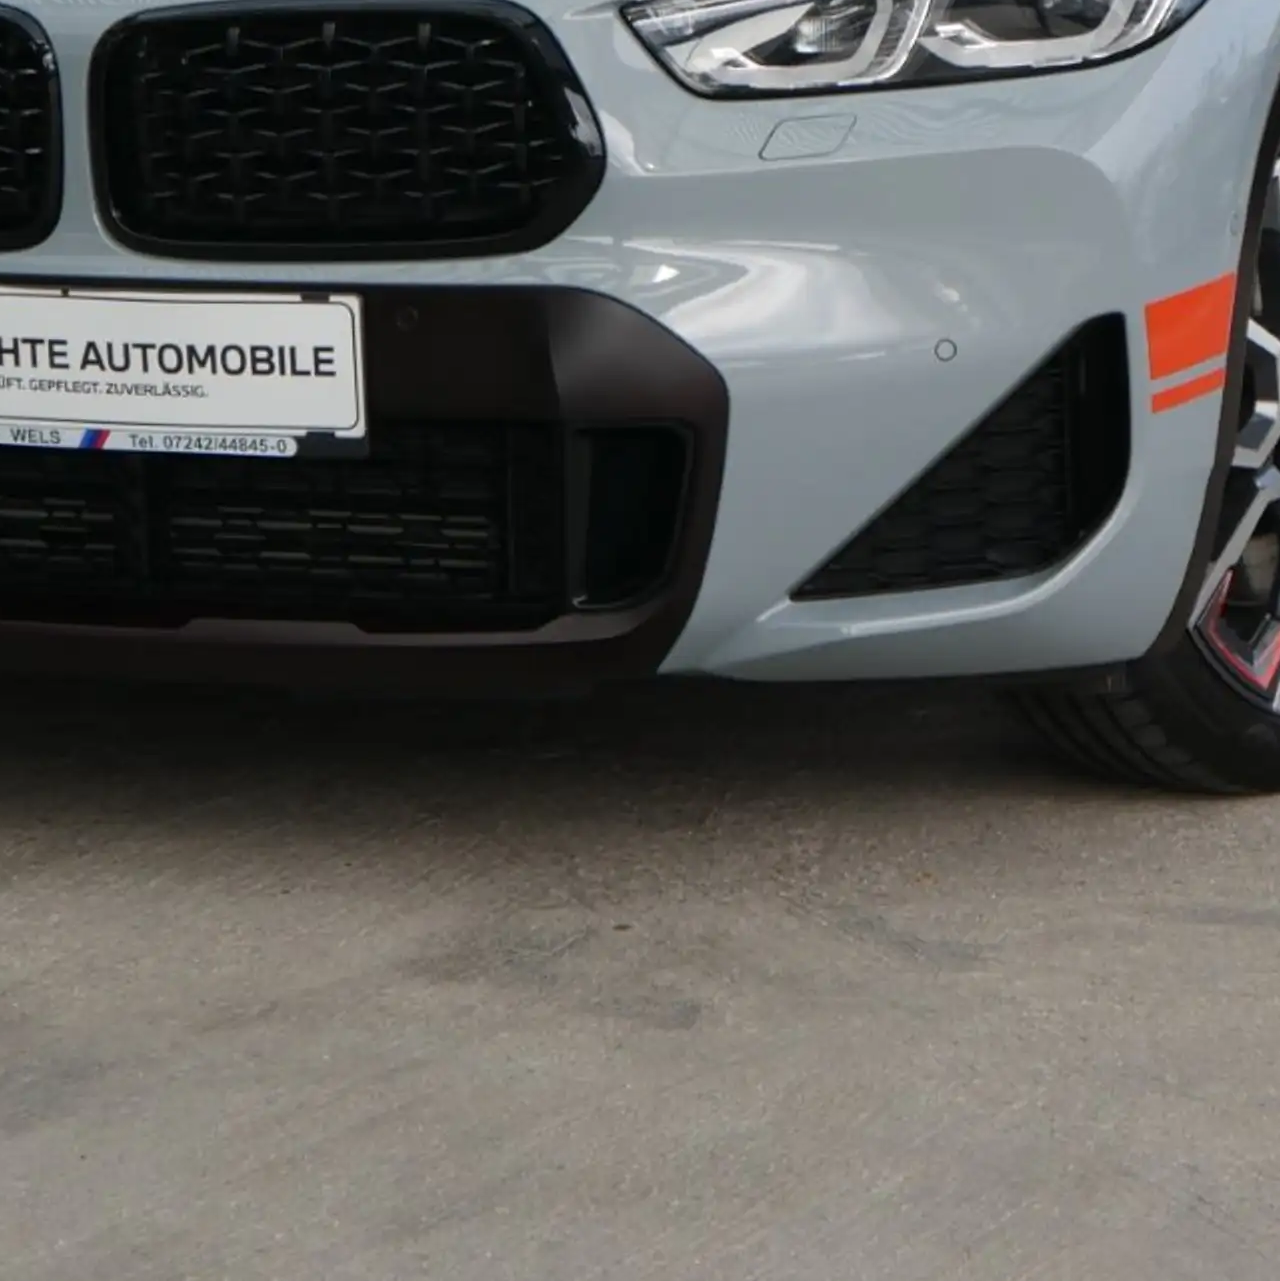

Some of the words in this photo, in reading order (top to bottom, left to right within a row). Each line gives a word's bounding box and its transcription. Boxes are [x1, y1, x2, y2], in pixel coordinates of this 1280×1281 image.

[80, 340, 337, 377] AUTOMOBILE
[28, 380, 102, 395] GEPFLEGT.
[105, 381, 209, 398] ZUVERLÄSSIG.
[10, 428, 62, 445] WELS
[128, 433, 158, 450] Tel.
